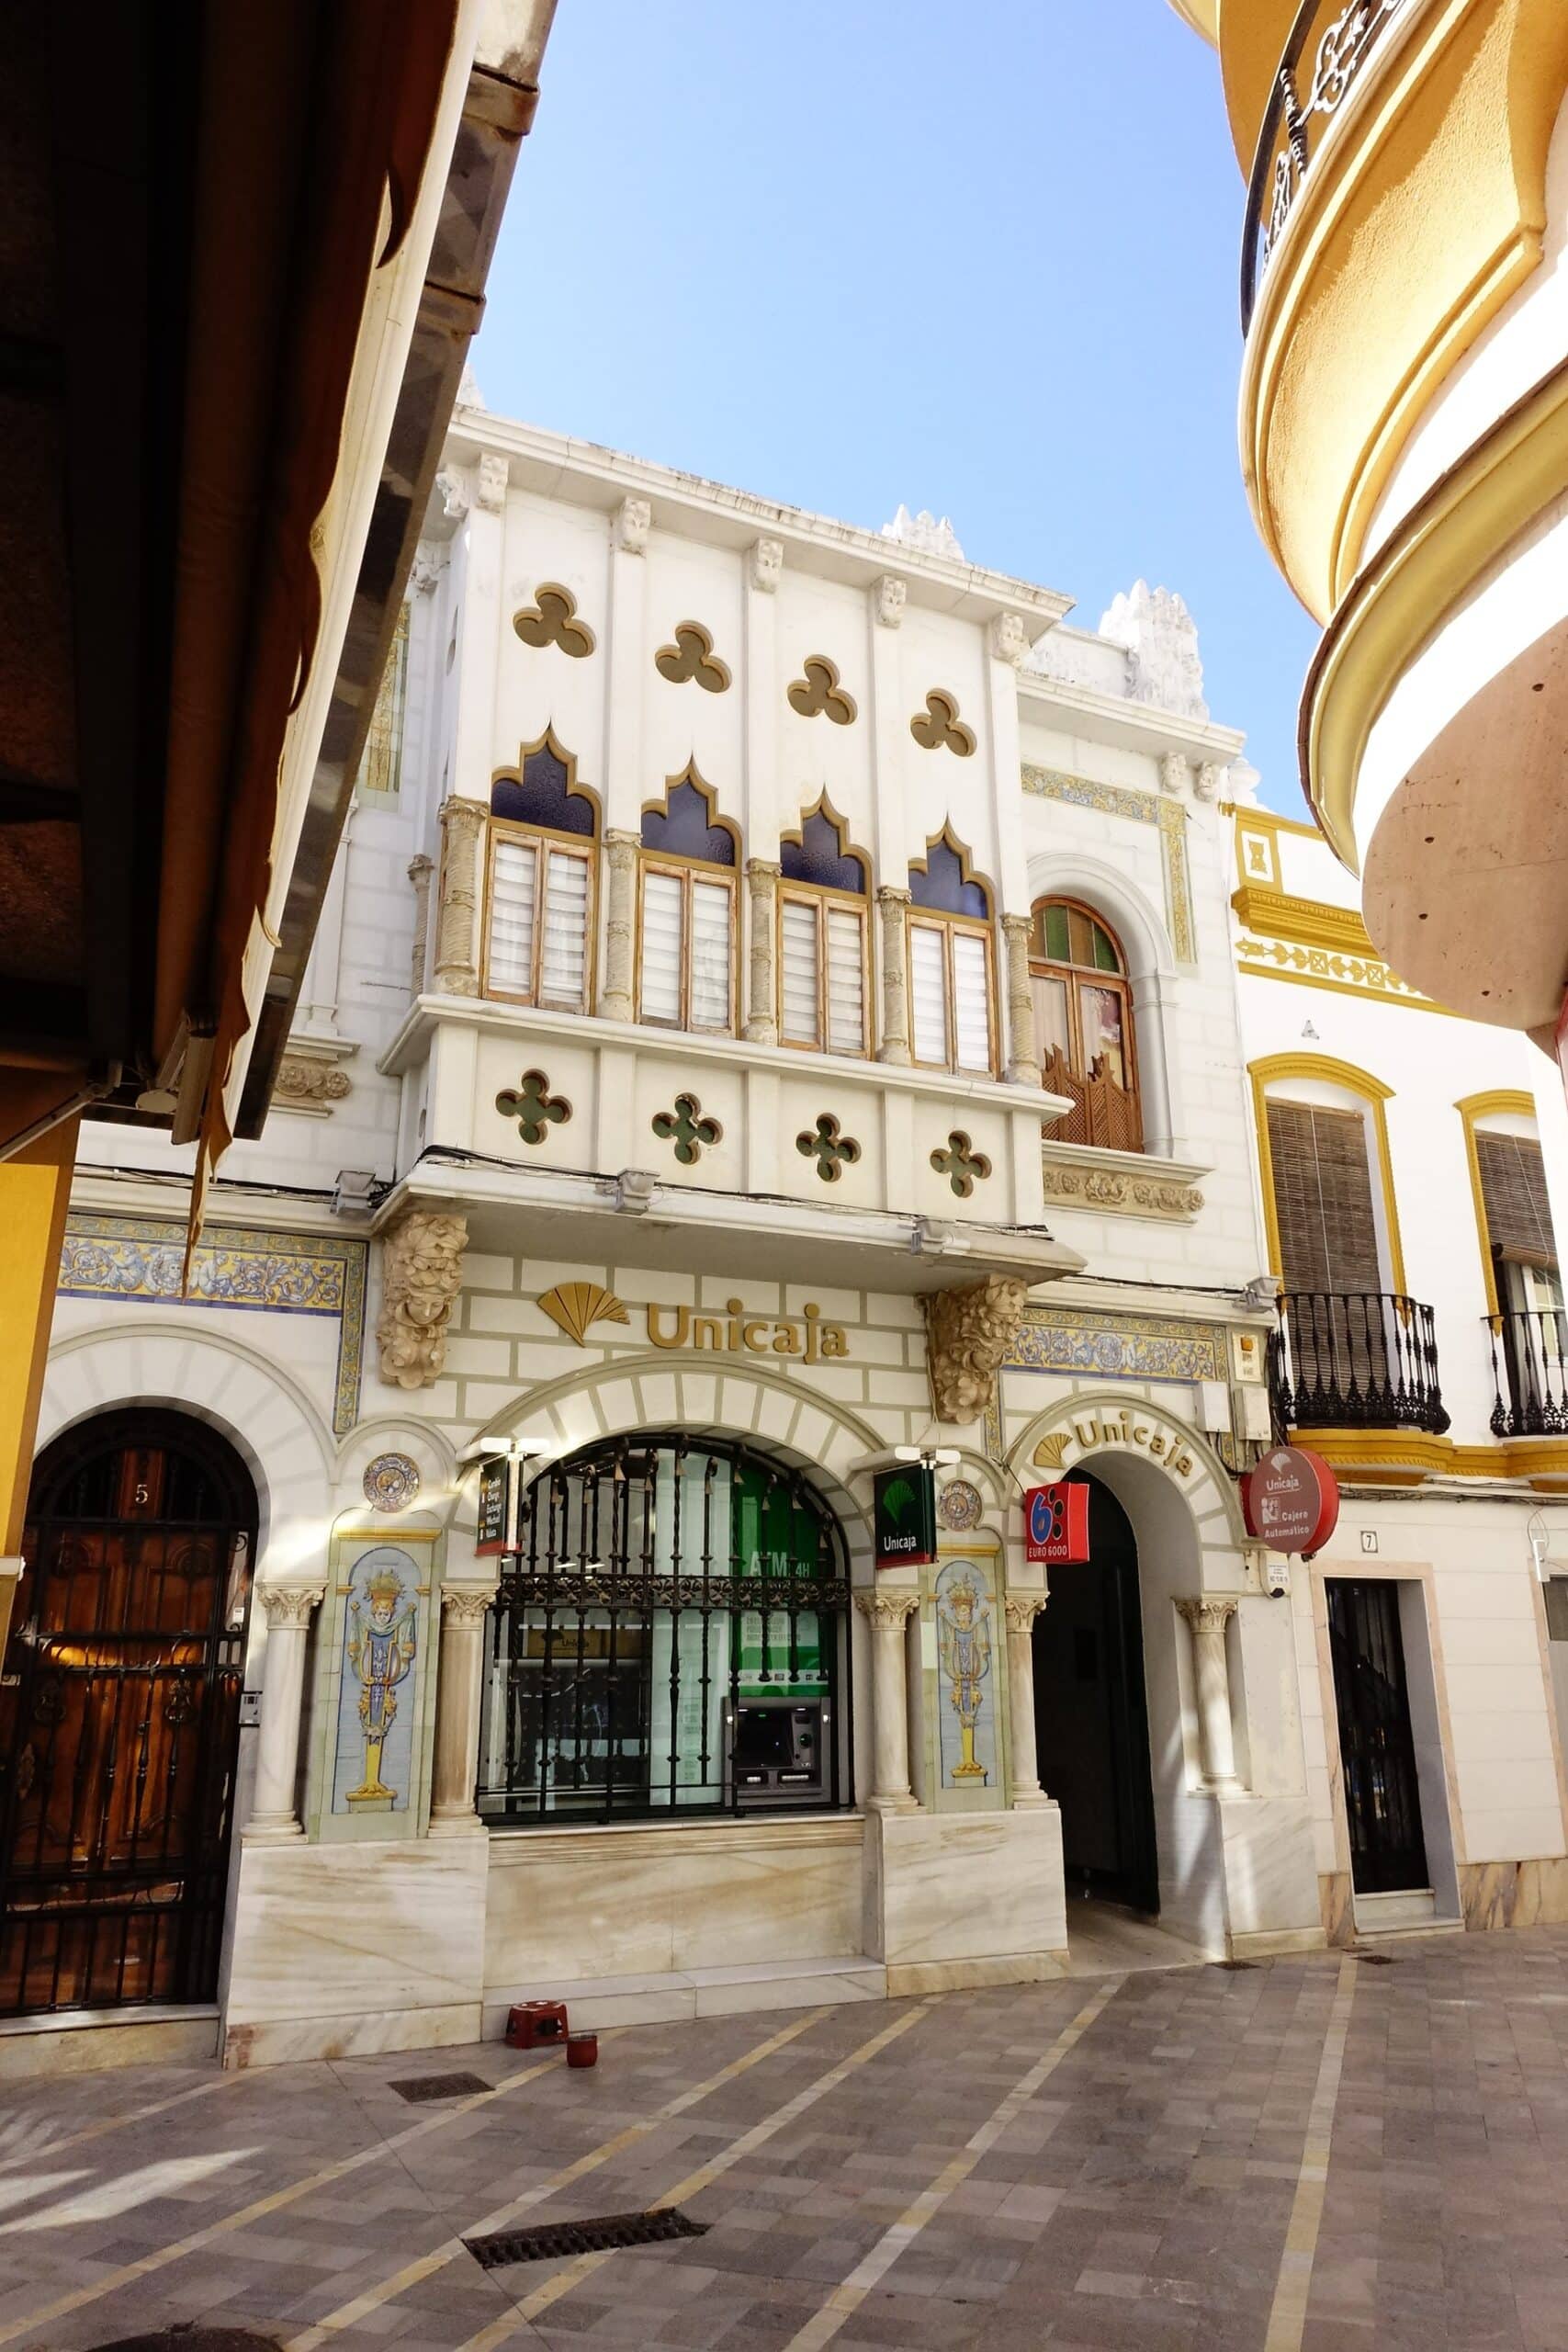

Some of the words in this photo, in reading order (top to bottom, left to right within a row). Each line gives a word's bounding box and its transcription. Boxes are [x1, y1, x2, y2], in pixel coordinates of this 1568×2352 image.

[647, 1298, 849, 1364] Unicaja
[1075, 1410, 1193, 1477] Unicaja
[1266, 1475, 1300, 1491] Unicaja
[135, 1484, 148, 1504] 5
[1281, 1510, 1309, 1521] Cajero
[884, 1529, 917, 1552] Unicaja
[1366, 1534, 1371, 1548] 7
[1029, 1546, 1046, 1558] EURO
[1048, 1545, 1066, 1556] 6000
